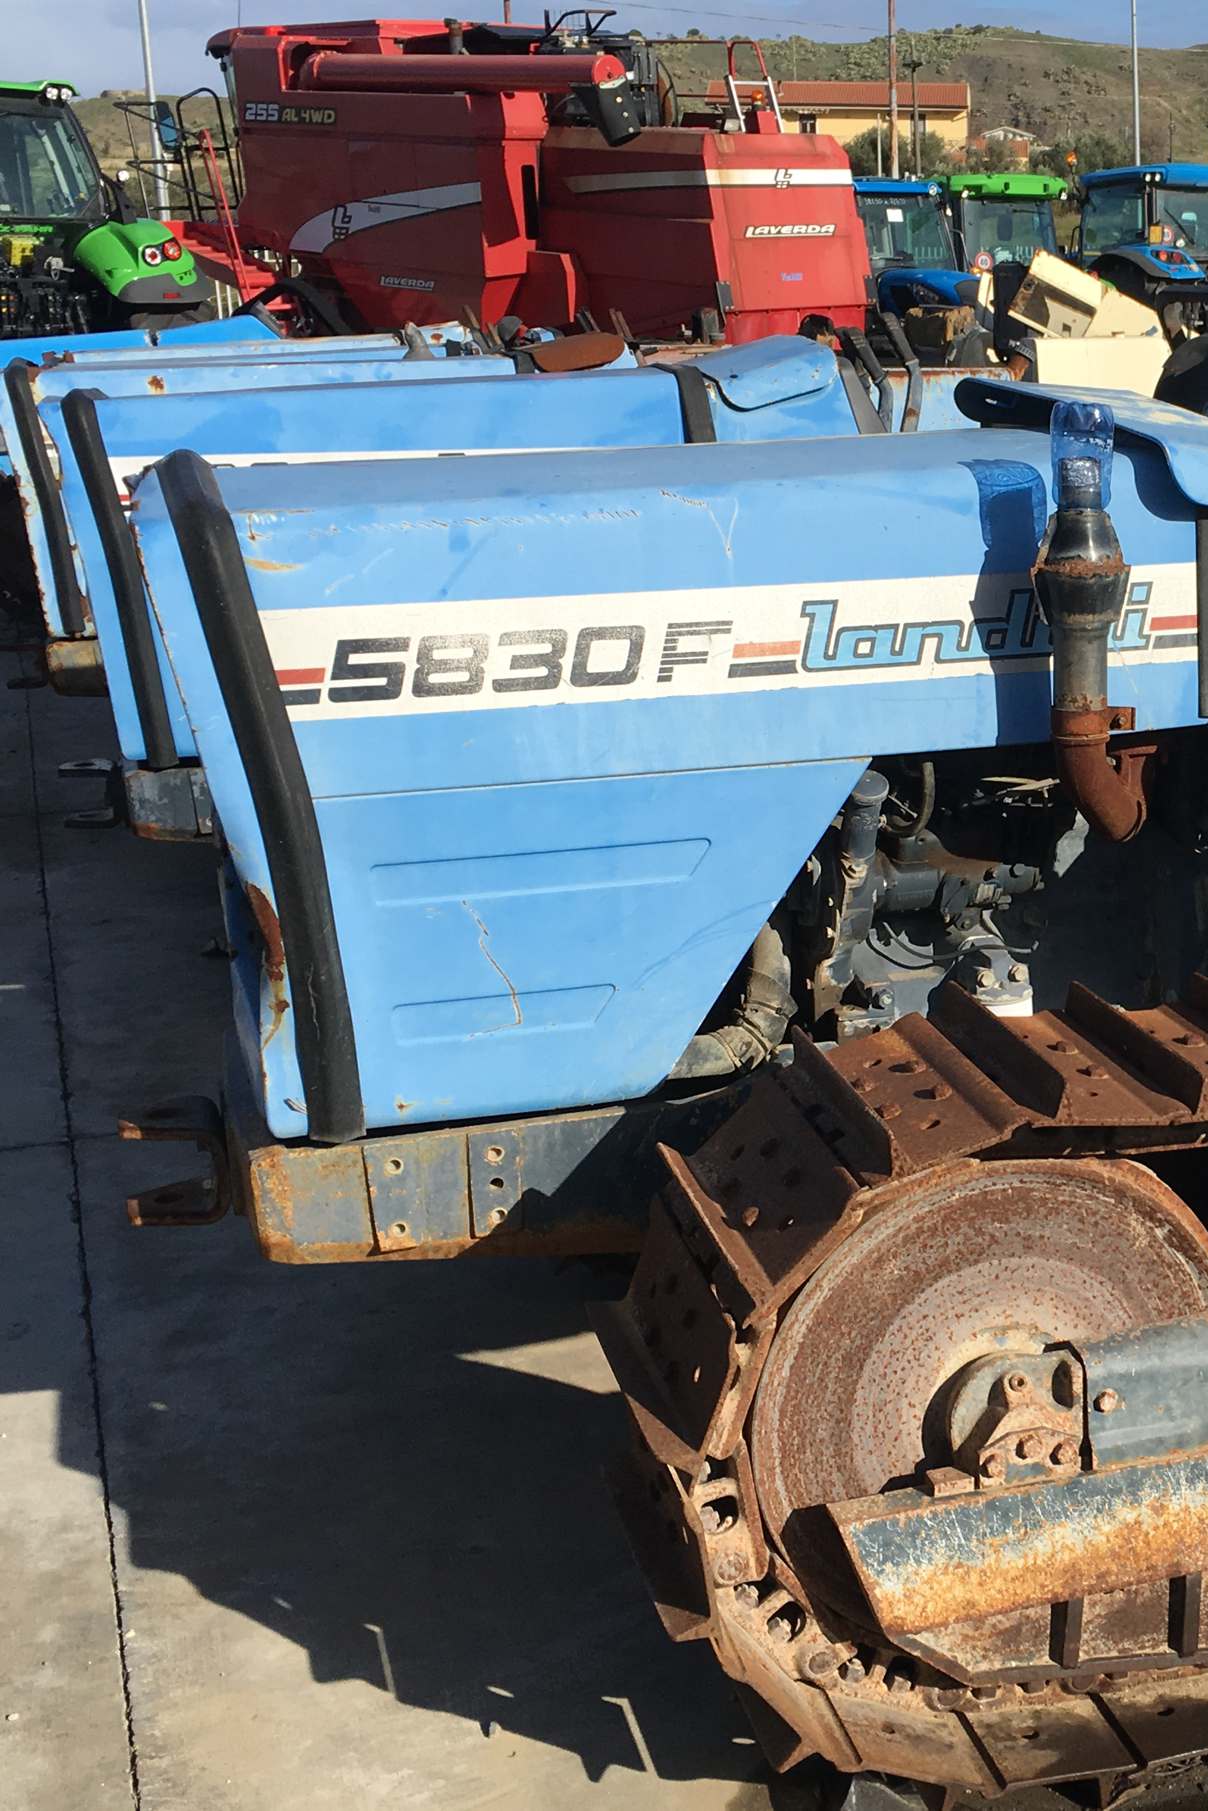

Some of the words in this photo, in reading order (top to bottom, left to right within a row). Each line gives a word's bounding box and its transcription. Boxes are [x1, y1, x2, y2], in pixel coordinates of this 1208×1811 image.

[245, 103, 279, 121] 255
[281, 108, 299, 122] AL
[301, 109, 336, 124] 4WD
[745, 224, 836, 239] LAVERDA
[380, 276, 434, 291] LAVERDA
[799, 581, 1153, 673] landi
